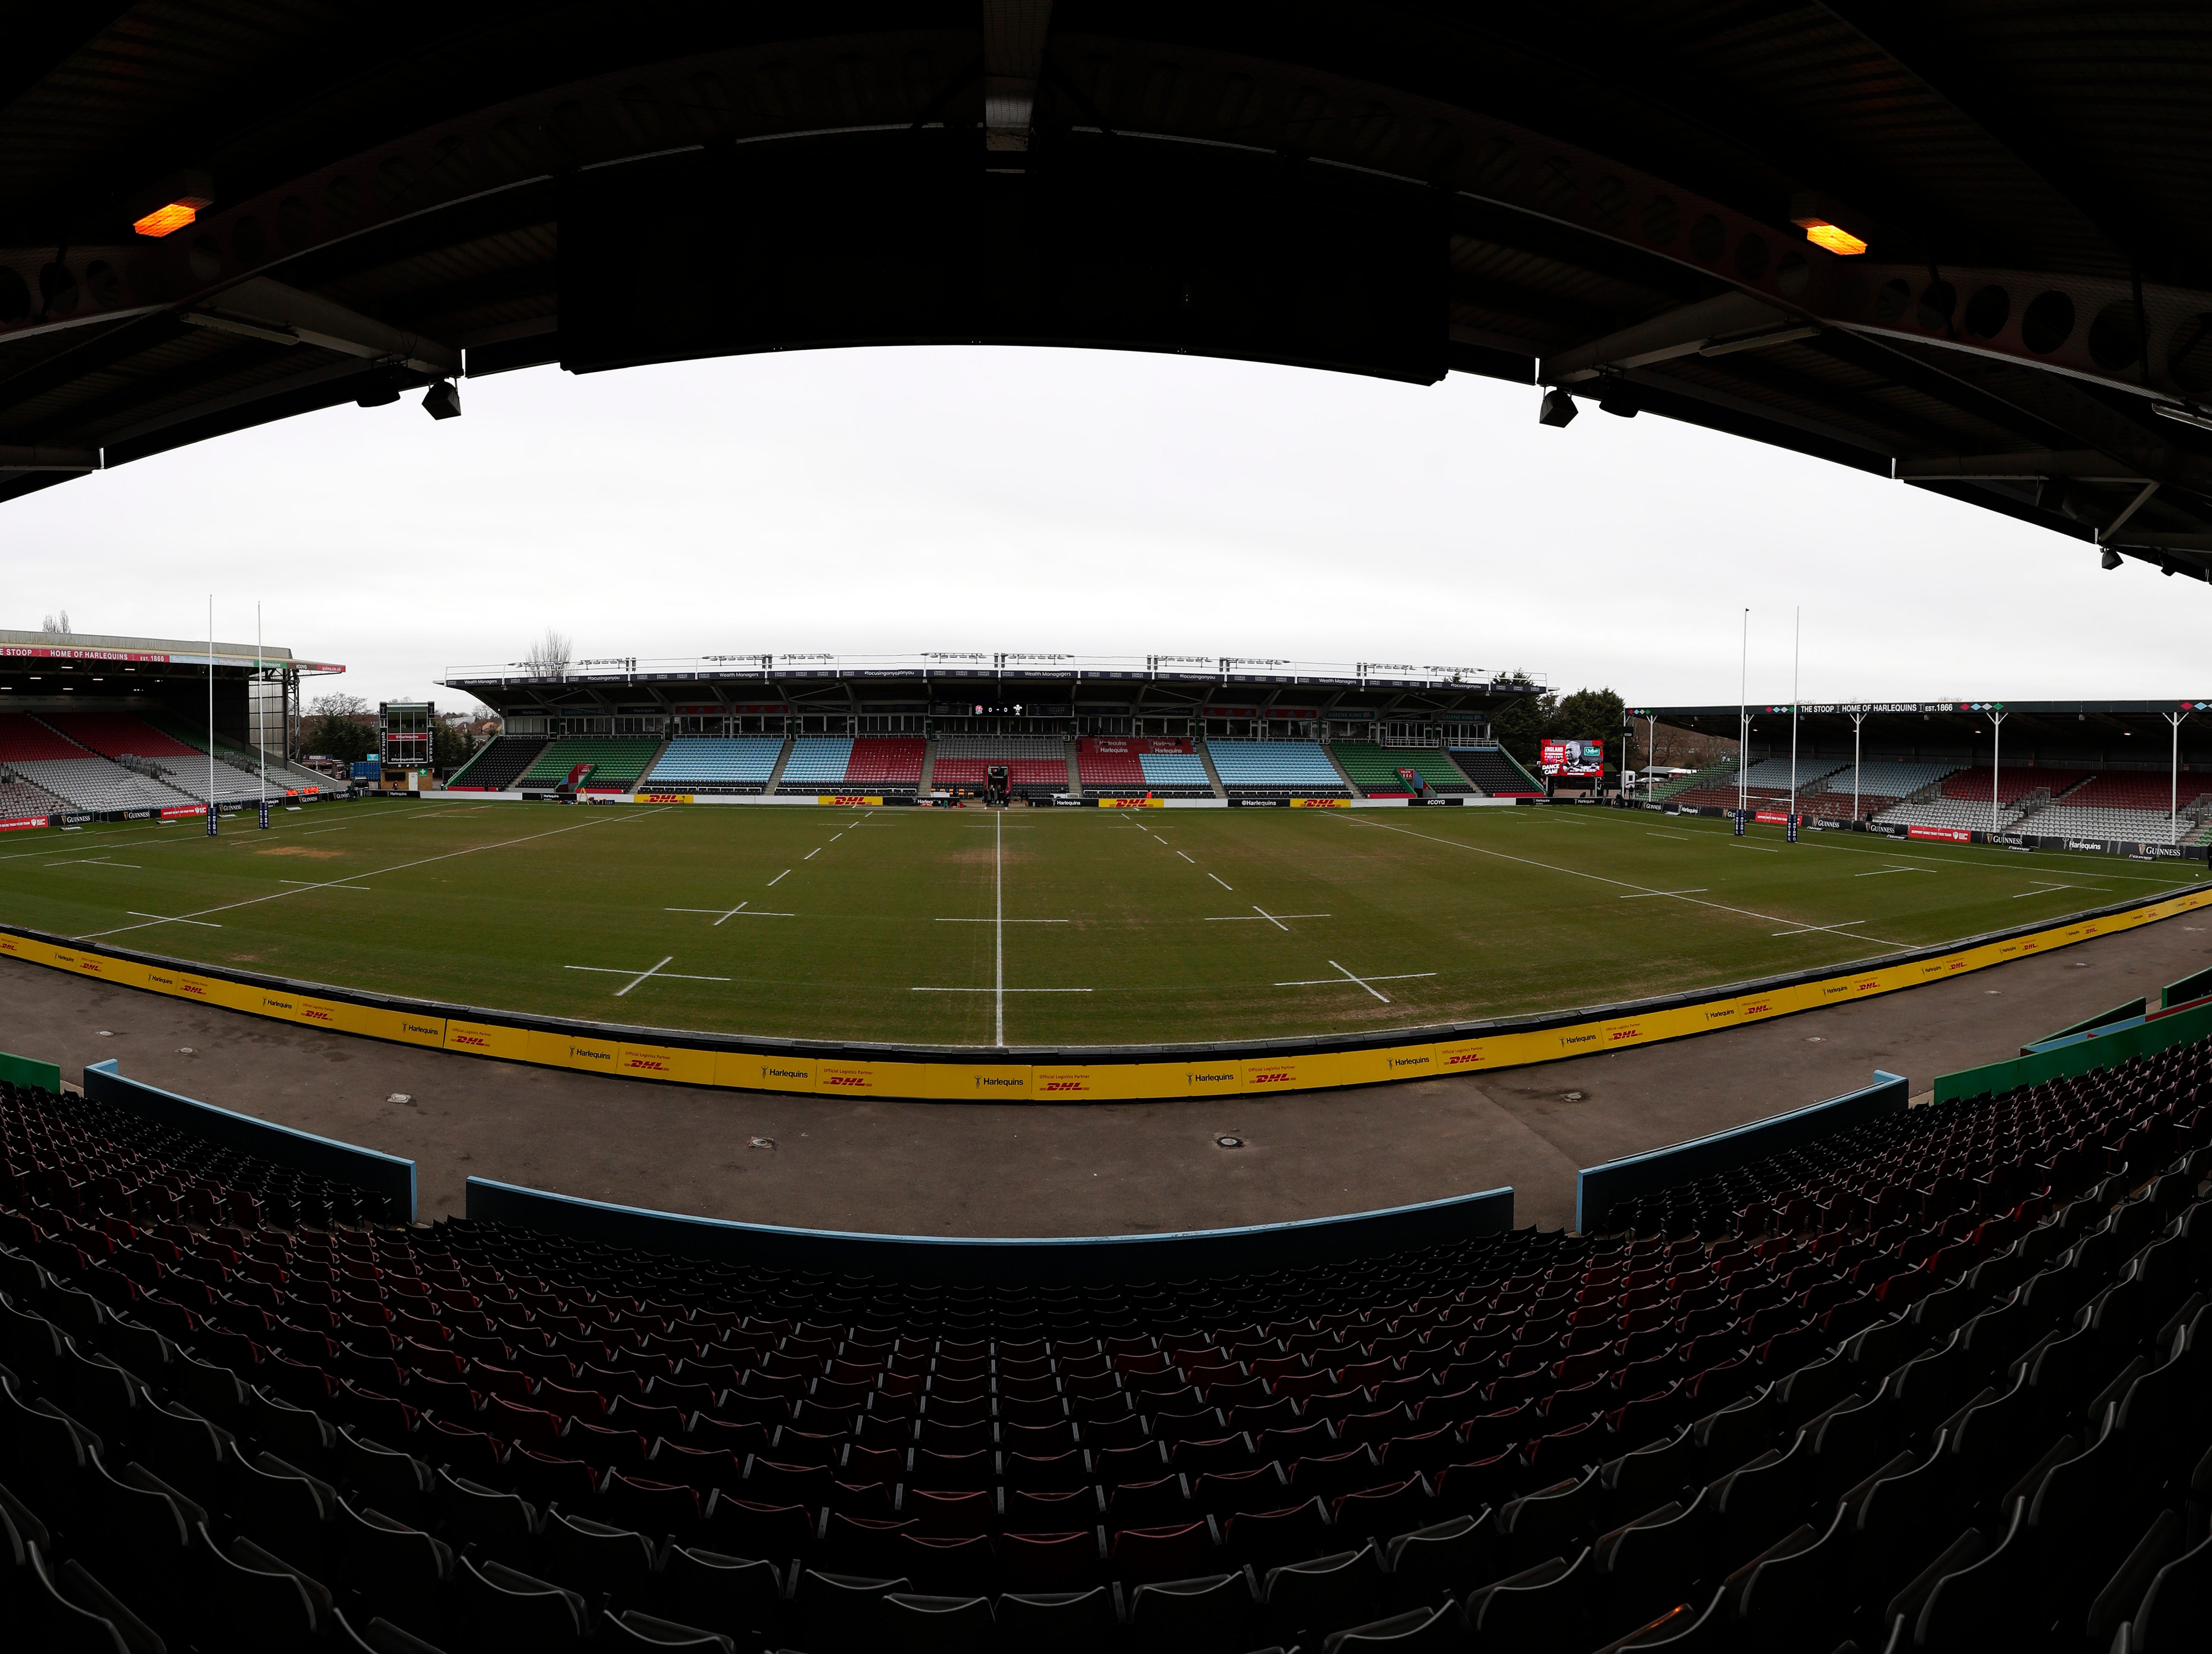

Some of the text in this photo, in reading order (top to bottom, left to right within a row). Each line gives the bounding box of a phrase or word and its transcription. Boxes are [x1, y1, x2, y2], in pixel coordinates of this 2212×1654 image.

[85, 652, 128, 660] HARLEQUINS
[648, 795, 678, 803] DHL
[1115, 799, 1147, 807] DHL
[1871, 825, 1894, 833] GUINNESS
[1993, 835, 2022, 844] GUINNESS
[2069, 841, 2101, 850] Harlequins
[2146, 847, 2180, 856] GUINNESS
[152, 976, 172, 984] Harlequins
[184, 985, 202, 994] DHL
[1859, 982, 1877, 990] DHL
[267, 1000, 292, 1009] Harlequins
[1710, 1010, 1734, 1018] Harlequins
[1748, 1005, 1768, 1015] DHL
[305, 1010, 328, 1020] DHL
[409, 1025, 438, 1035] Harlequins
[1566, 1034, 1596, 1043] Harlequins
[1613, 1030, 1638, 1040] DHL
[457, 1036, 484, 1046] DHL
[576, 1049, 610, 1059] Harlequins
[1395, 1057, 1429, 1065] Harlequins
[1450, 1054, 1479, 1064] DHL
[630, 1059, 663, 1070] DHL
[769, 1069, 807, 1078] Harlequins
[1195, 1073, 1233, 1082] Harlequins
[1256, 1073, 1290, 1083] DHL
[830, 1077, 865, 1086] DHL
[984, 1078, 1023, 1086] Harlequins
[1047, 1082, 1082, 1091] DHL
